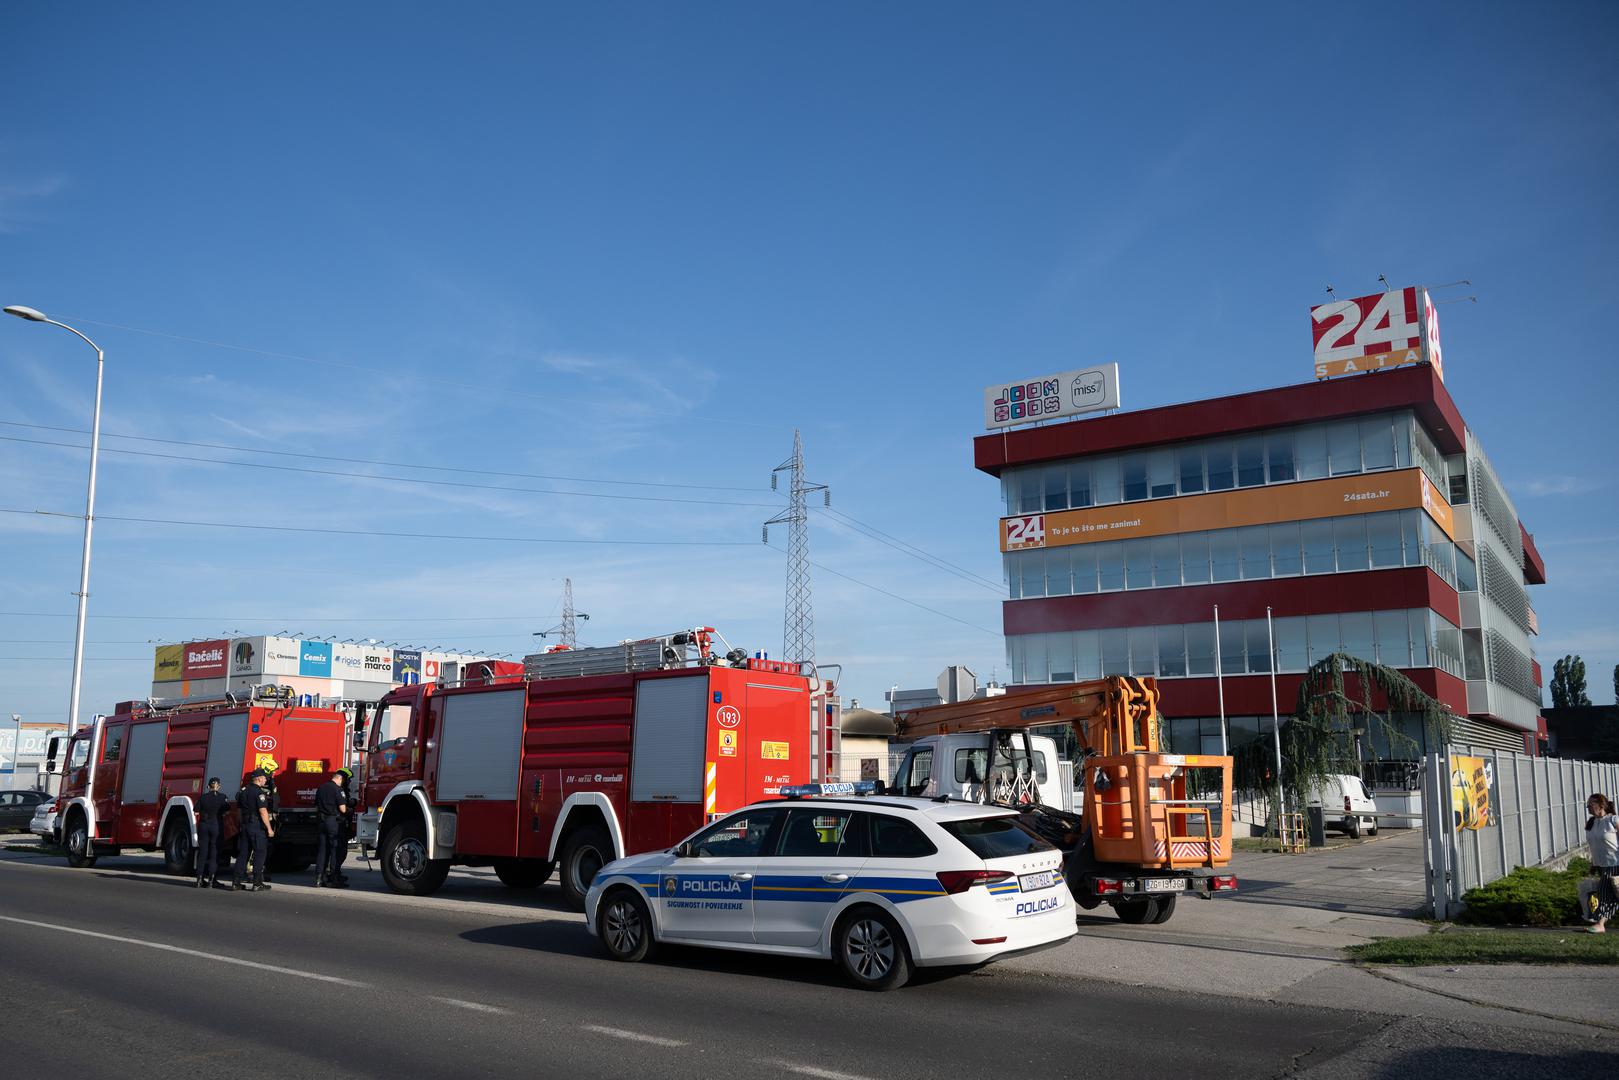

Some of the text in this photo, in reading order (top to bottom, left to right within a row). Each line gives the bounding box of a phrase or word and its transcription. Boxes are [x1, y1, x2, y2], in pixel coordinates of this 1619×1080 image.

[1311, 289, 1420, 363] 24
[1316, 350, 1419, 377] SATA
[1074, 379, 1103, 397] miss7
[1343, 489, 1391, 502] 24sata.hr
[1008, 517, 1045, 544] 24
[1052, 527, 1061, 536] To
[1062, 527, 1070, 536] je
[1096, 522, 1109, 530] me
[341, 656, 361, 667] rigips
[365, 655, 380, 663] san
[364, 662, 391, 671] marco
[722, 711, 737, 724] 193
[259, 739, 273, 749] 193
[823, 783, 854, 793] POLICIJA
[682, 880, 742, 893] POLICIJA
[1149, 880, 1158, 889] ZG
[667, 900, 701, 908] SIGURNOST
[705, 902, 743, 910] POVJERENJE
[1016, 897, 1058, 916] POLICIJA
